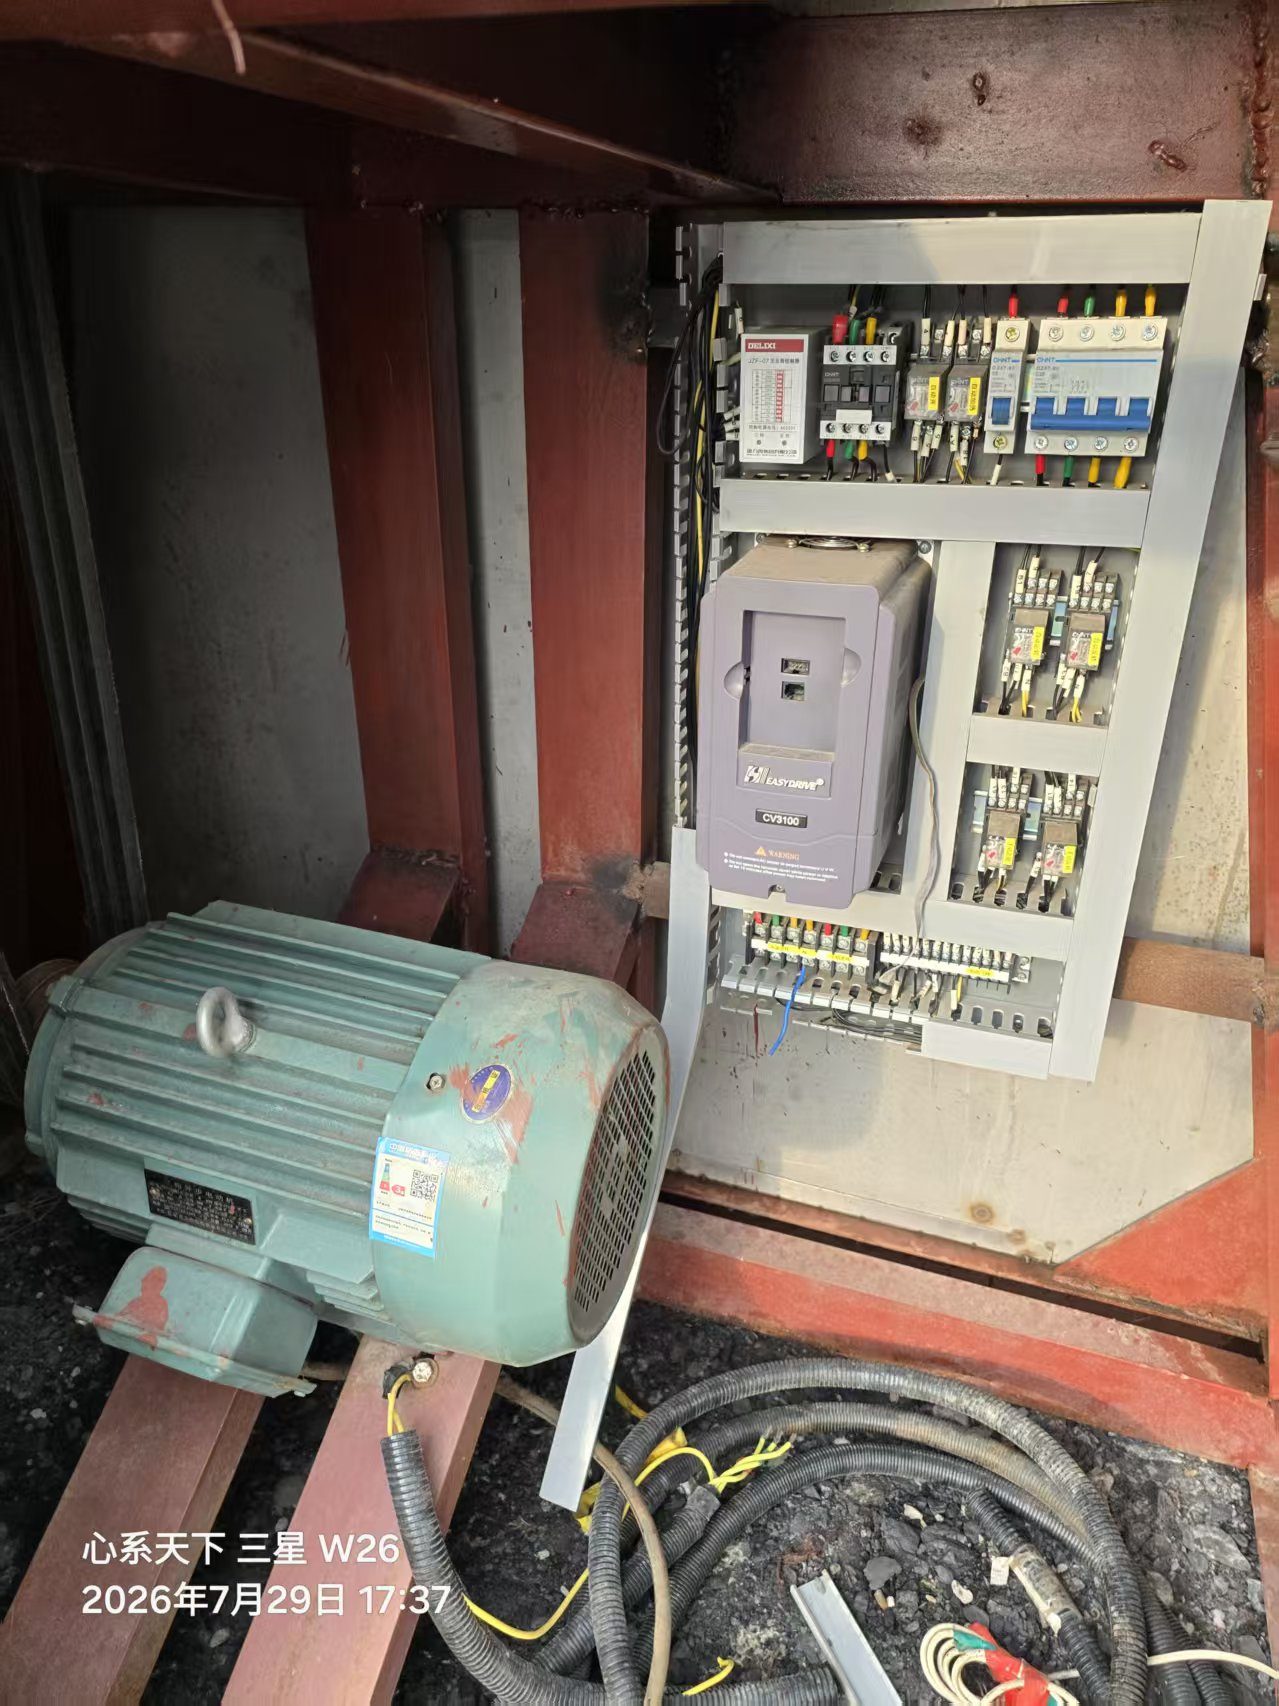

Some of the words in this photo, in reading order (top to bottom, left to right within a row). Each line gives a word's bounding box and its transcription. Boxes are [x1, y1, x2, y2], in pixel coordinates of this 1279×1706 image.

[747, 342, 776, 350] DELIXI
[764, 777, 817, 791] EASYDRIVE
[762, 813, 800, 827] CV3100
[767, 849, 800, 861] WARNING
